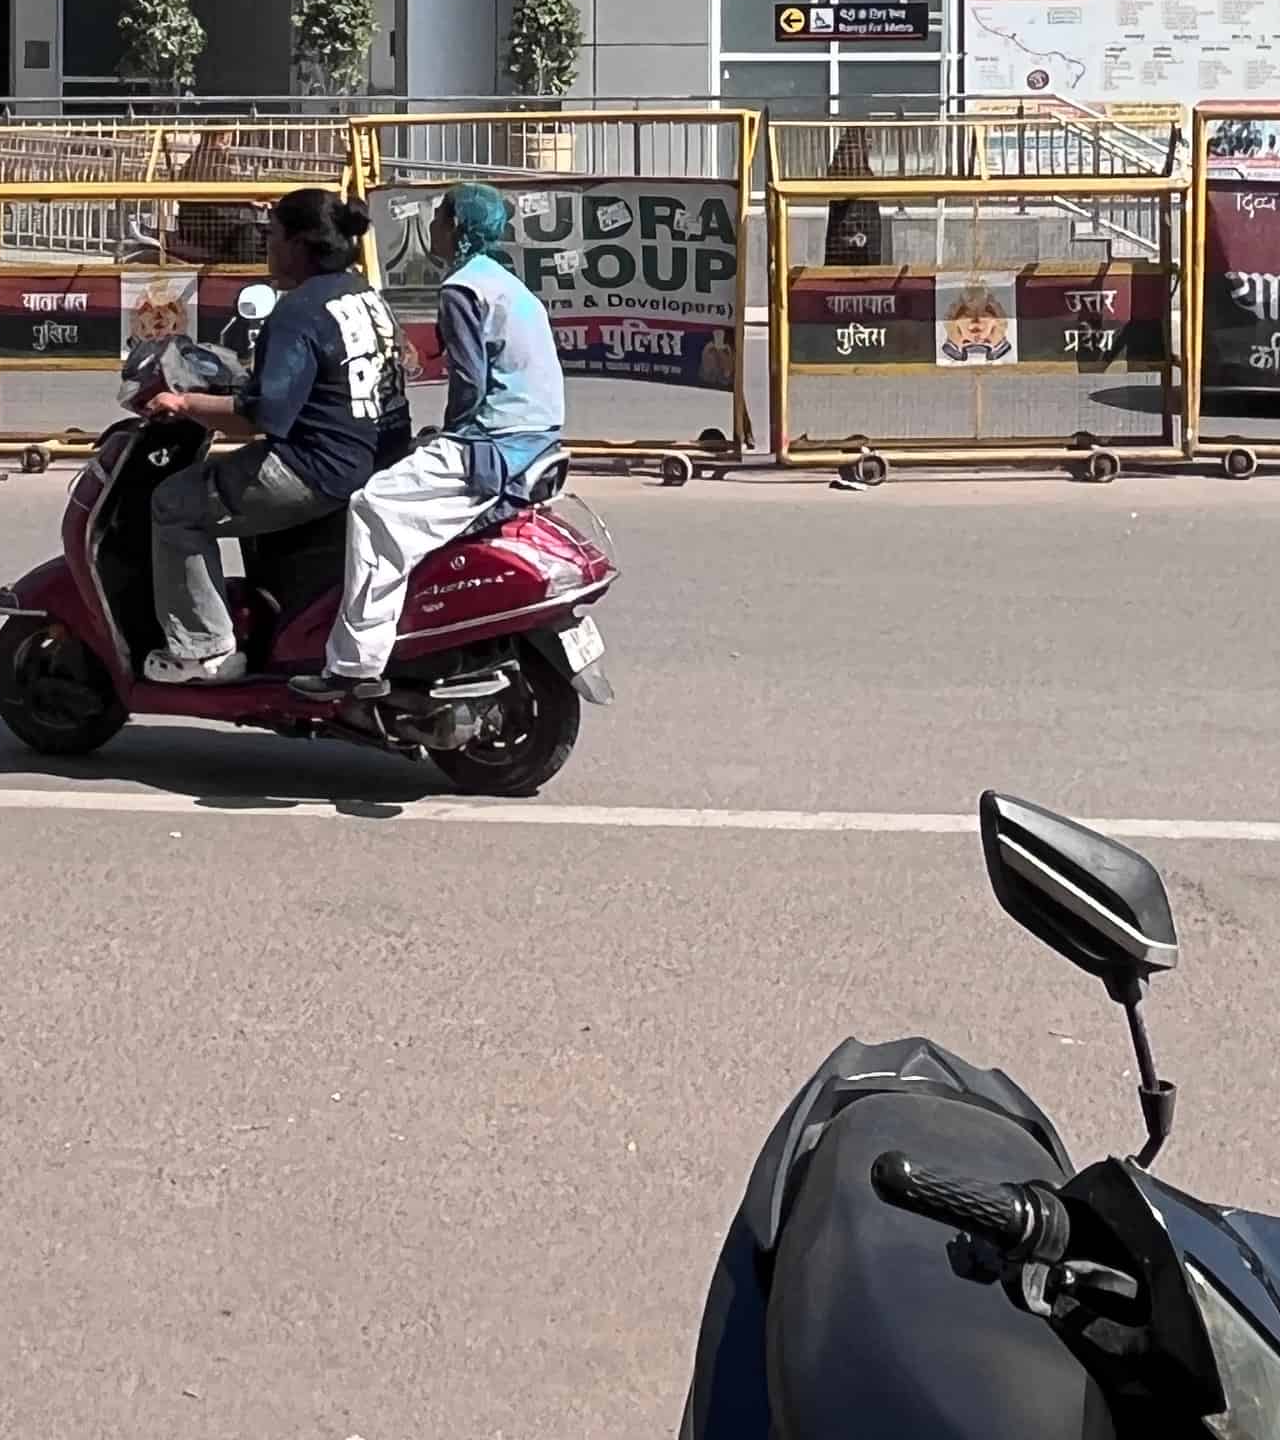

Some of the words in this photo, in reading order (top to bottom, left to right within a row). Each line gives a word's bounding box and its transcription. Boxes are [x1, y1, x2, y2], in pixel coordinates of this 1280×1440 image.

[583, 294, 598, 308] &
[1064, 289, 1119, 314] उत्तर
[32, 320, 79, 350] पुलिस
[599, 319, 685, 357] पुलिस
[835, 325, 886, 354] पुलिस
[1064, 326, 1115, 354] प्रदेश
